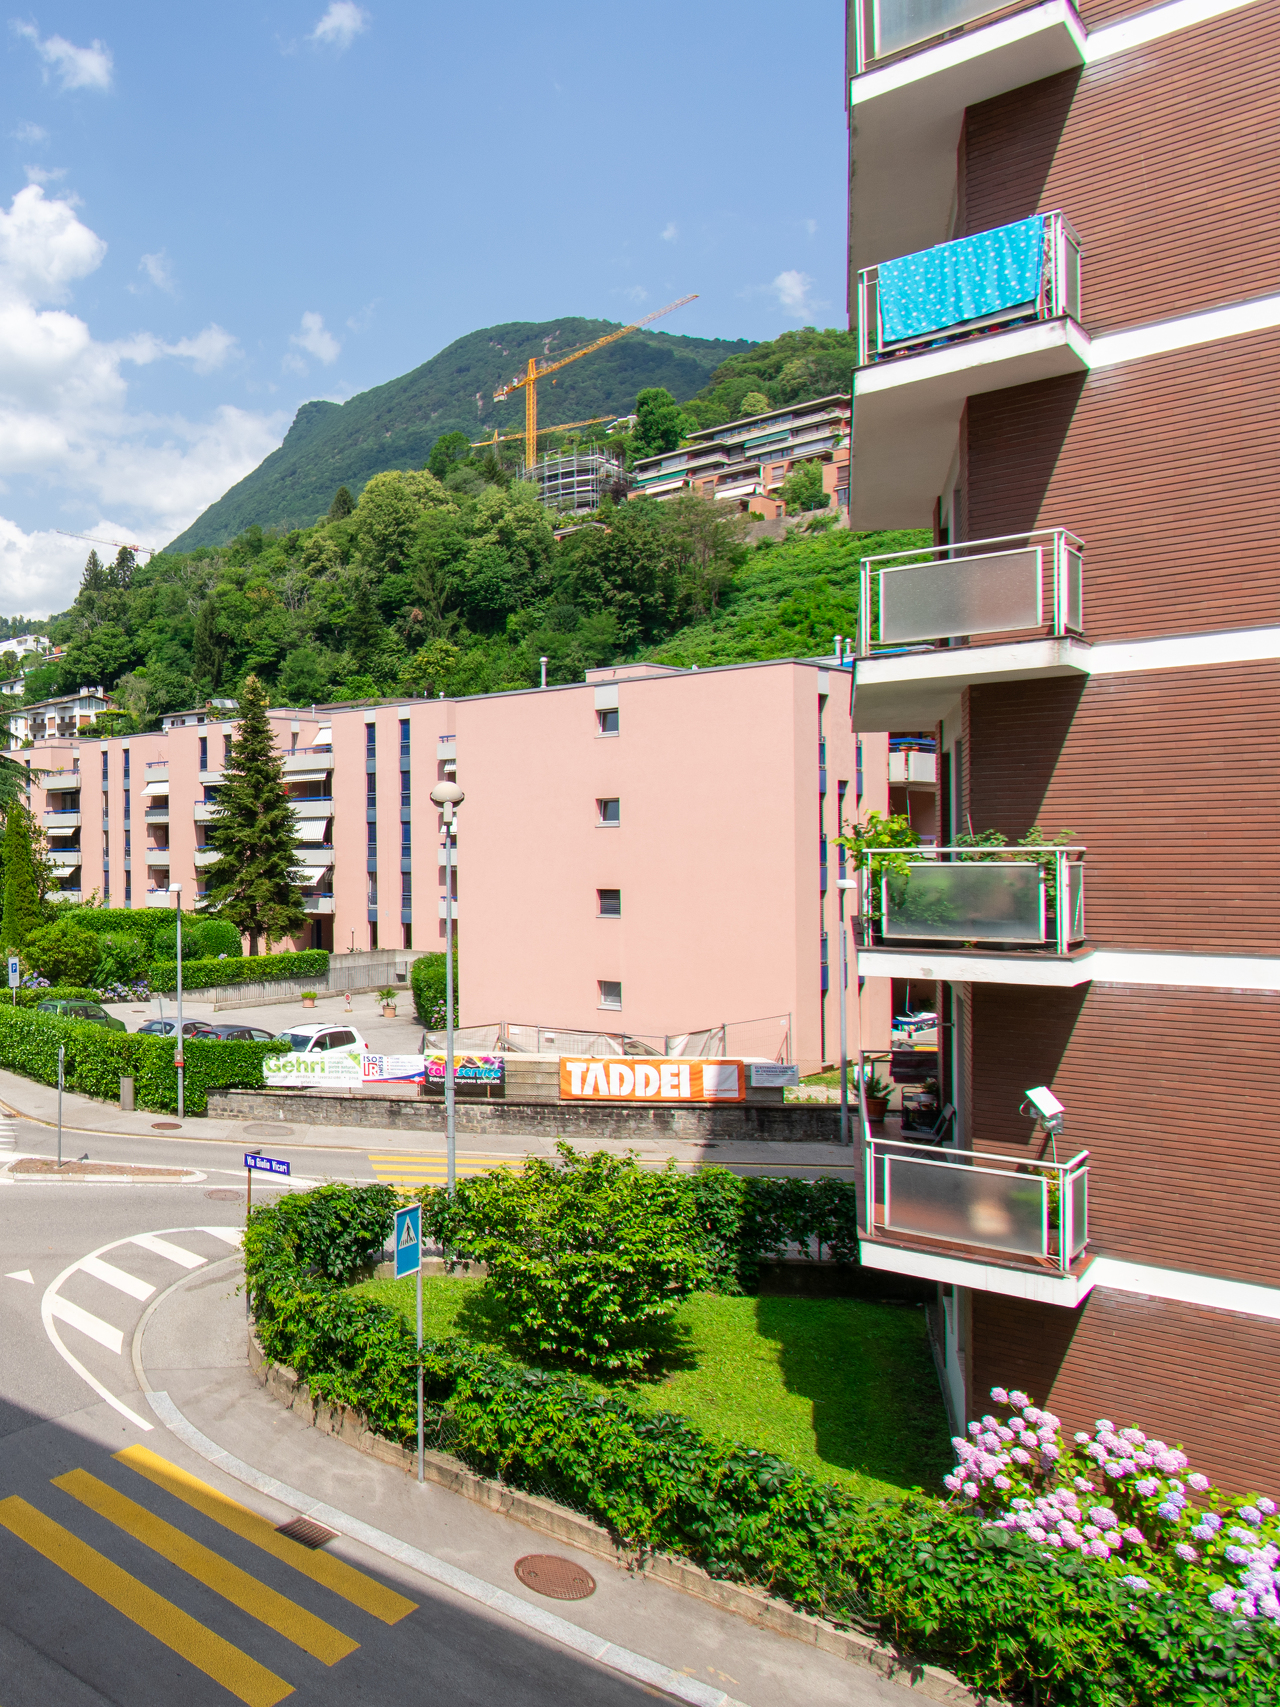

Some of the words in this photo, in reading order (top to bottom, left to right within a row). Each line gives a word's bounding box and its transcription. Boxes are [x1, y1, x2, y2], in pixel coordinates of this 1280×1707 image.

[265, 1056, 326, 1074] Gehri
[566, 1062, 691, 1098] TADDEI
[246, 1156, 255, 1166] Via
[256, 1158, 270, 1169] Giulio
[272, 1161, 287, 1172] Vicari
